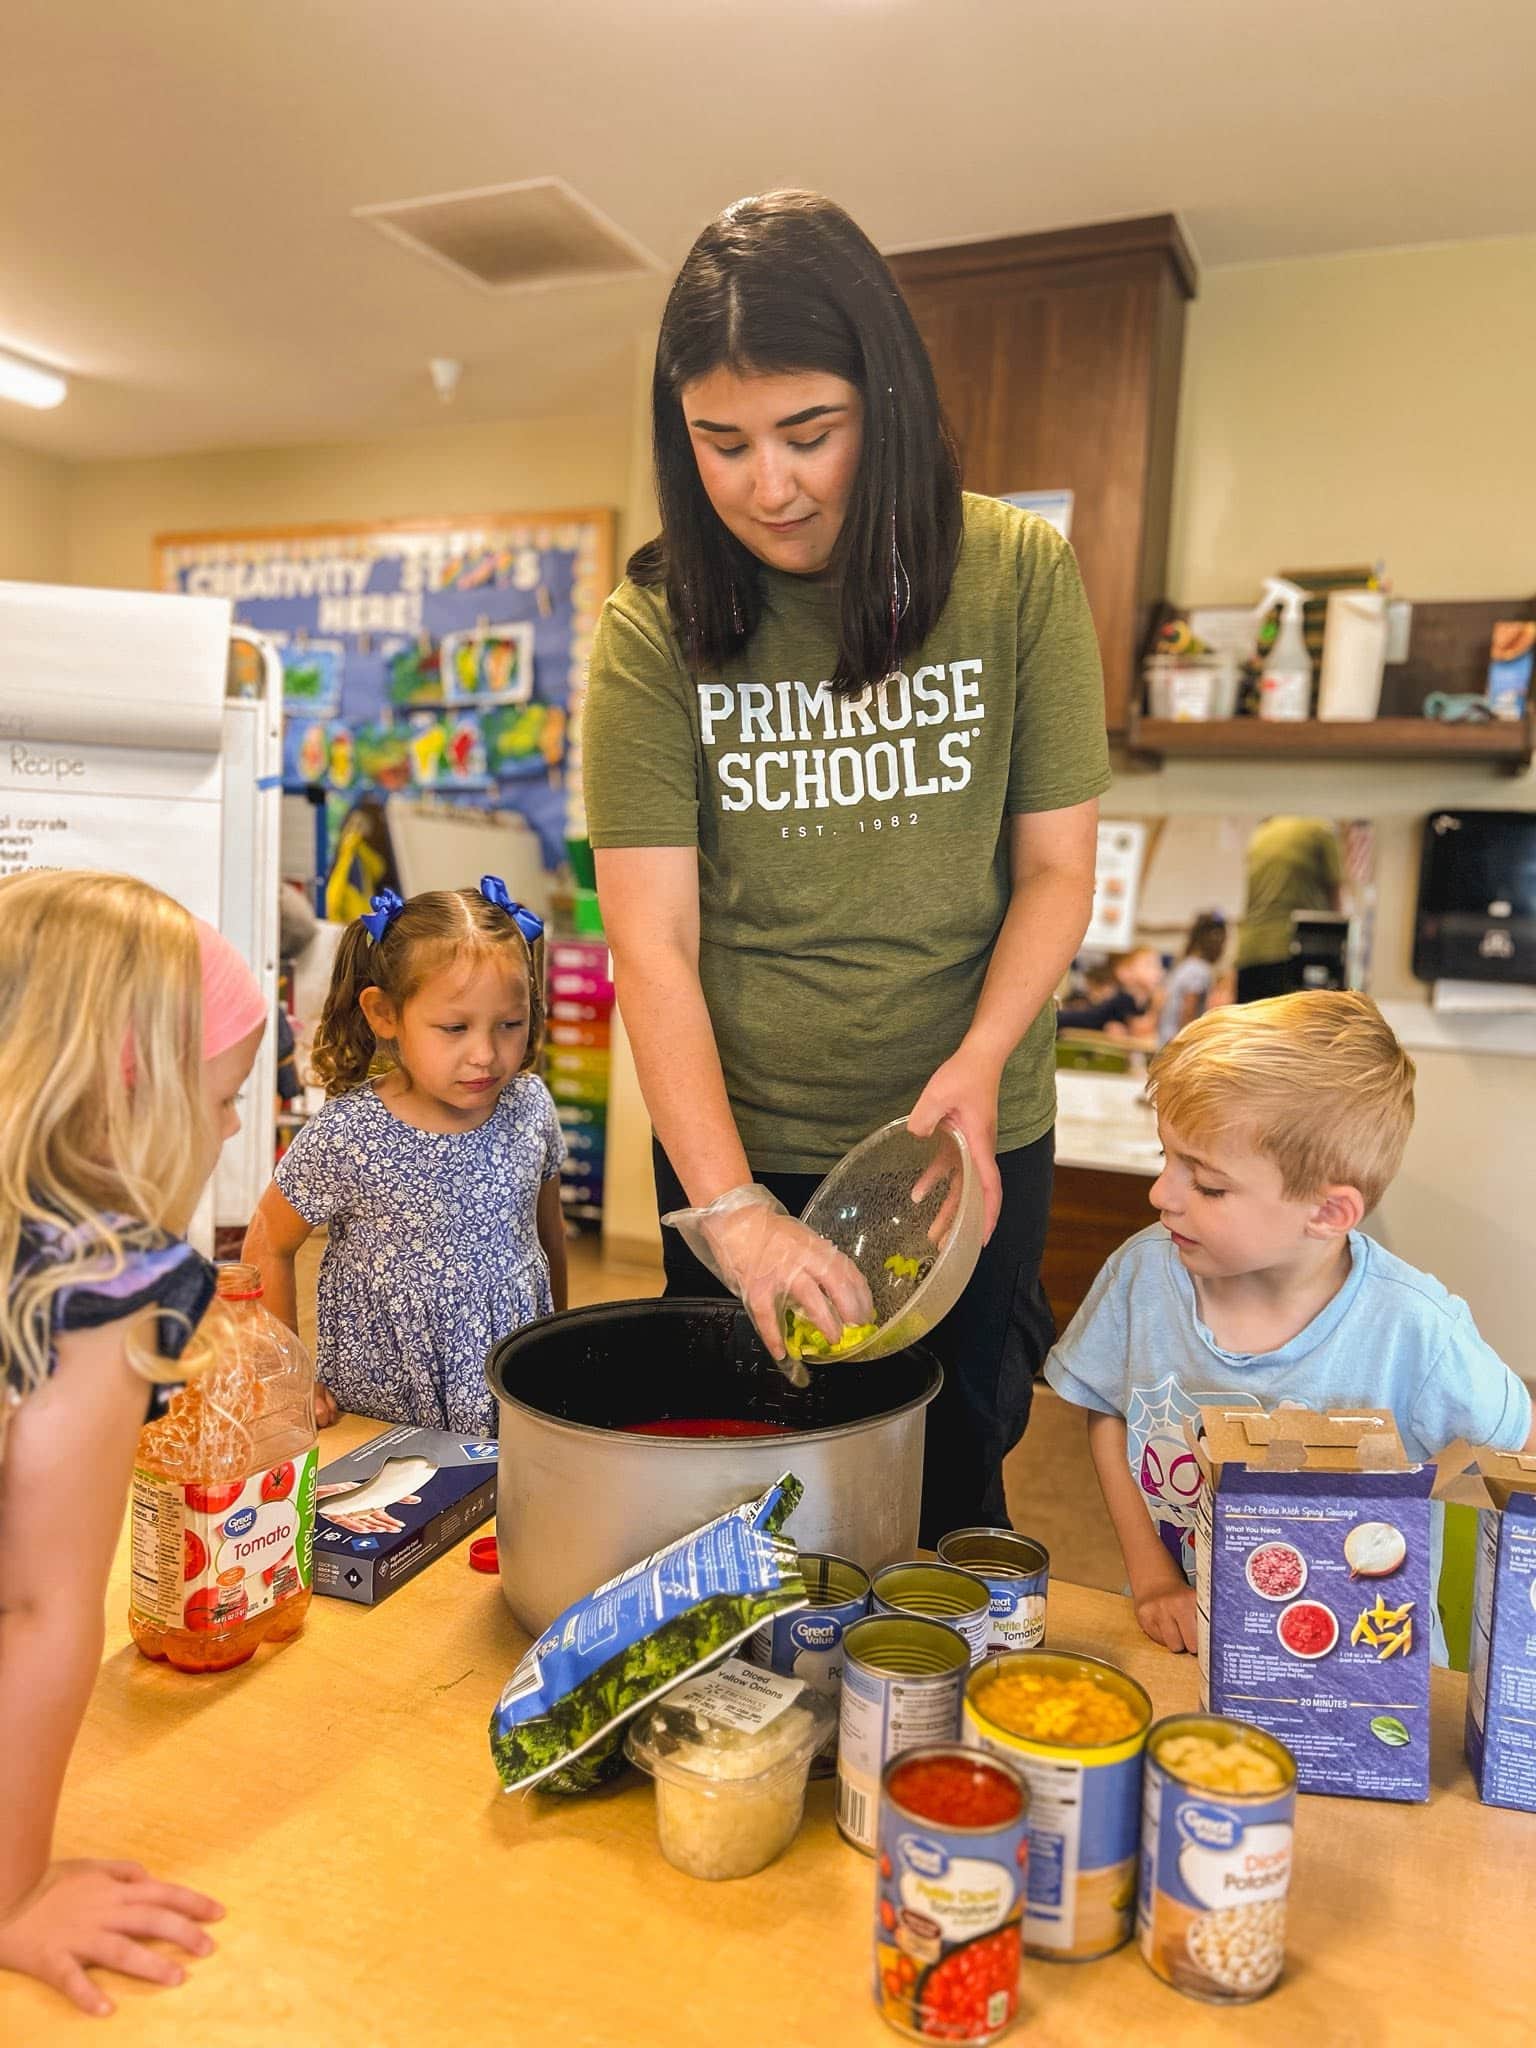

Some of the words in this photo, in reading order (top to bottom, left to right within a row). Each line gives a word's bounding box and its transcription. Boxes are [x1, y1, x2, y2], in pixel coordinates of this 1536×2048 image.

[697, 659, 985, 745] PRIMROSE
[9, 743, 85, 780] Recipe
[781, 824, 838, 839] EST.
[858, 812, 919, 833] 1982
[228, 1511, 253, 1528] Great
[1245, 1526, 1259, 1534] You
[234, 1525, 291, 1560] Tomato
[990, 1596, 1011, 1606] reat
[797, 1623, 834, 1636] Great
[806, 1636, 834, 1645] Value
[741, 1669, 771, 1684] Diced
[749, 1681, 784, 1700] Onions
[1300, 1697, 1312, 1706] 20
[1312, 1698, 1348, 1708] MINUTES
